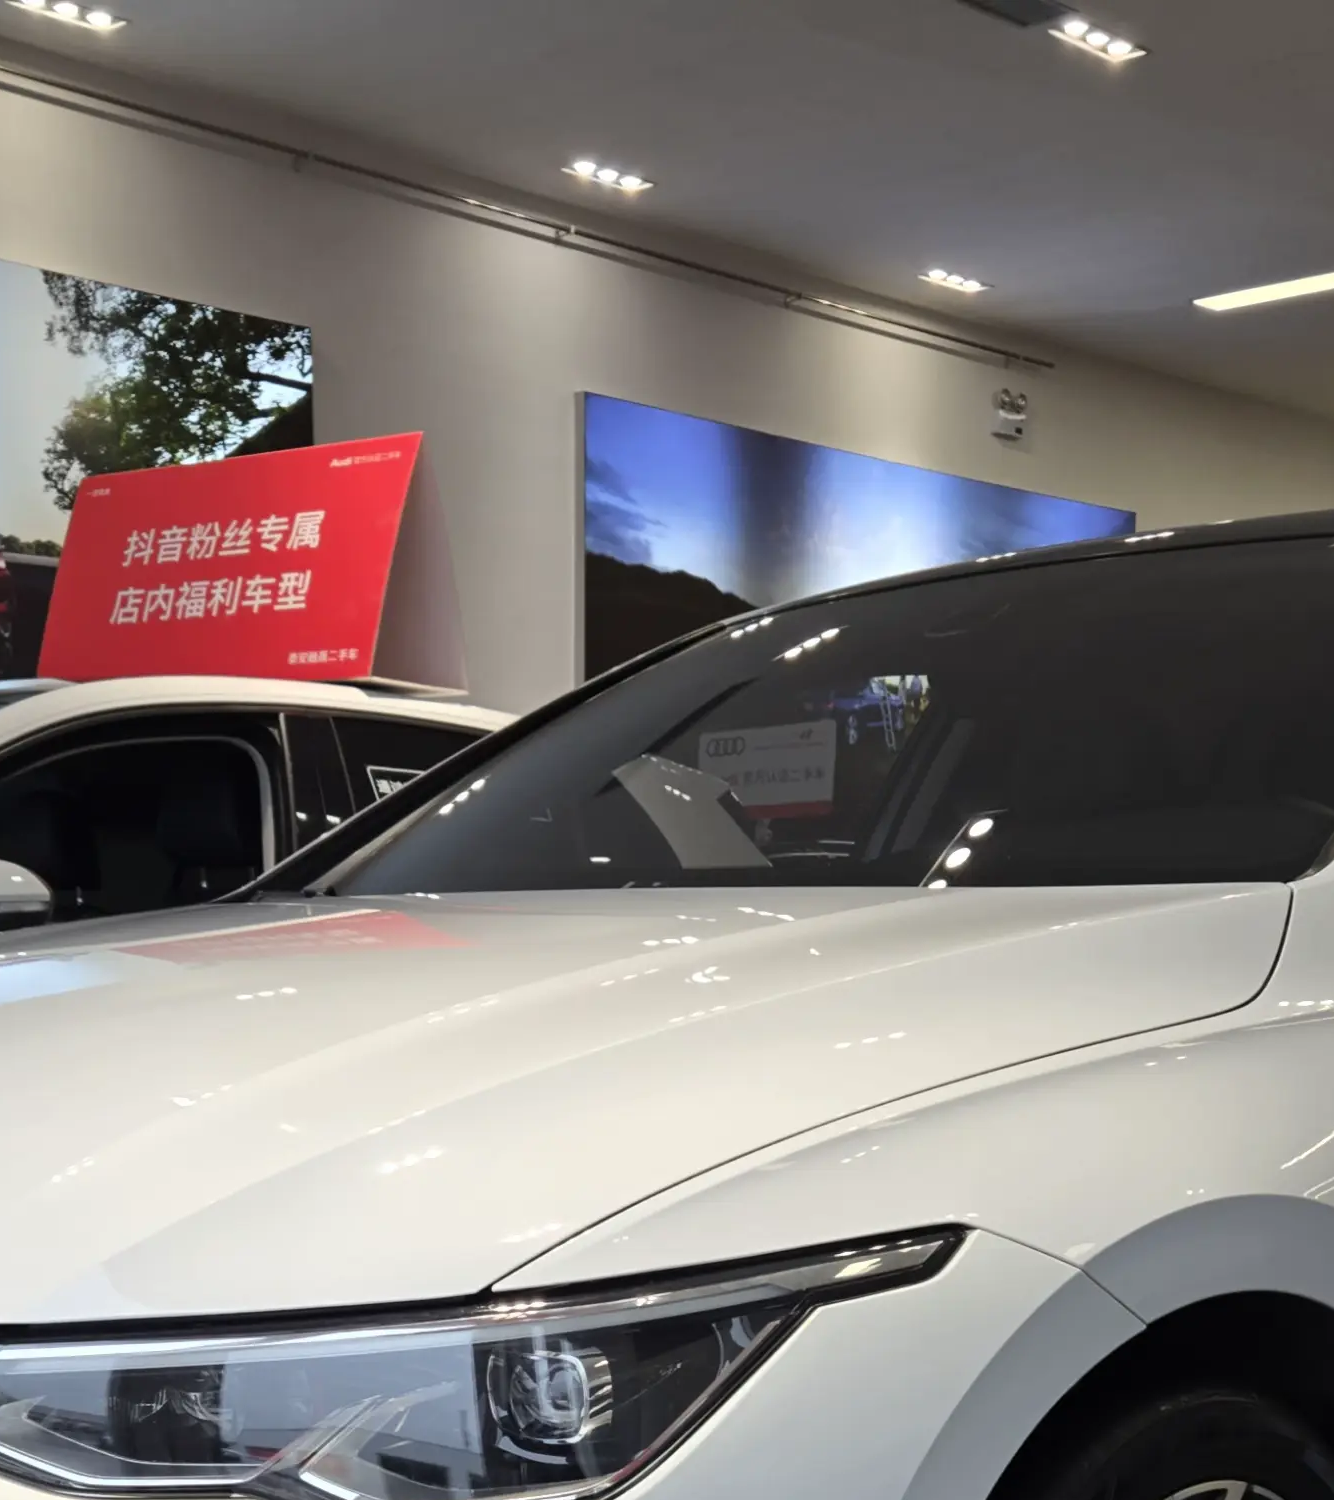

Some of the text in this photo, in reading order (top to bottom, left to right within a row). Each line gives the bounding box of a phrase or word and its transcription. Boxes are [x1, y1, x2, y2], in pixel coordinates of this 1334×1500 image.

[122, 509, 326, 567] 抖音粉丝专属
[109, 569, 312, 626] 店内福利车型
